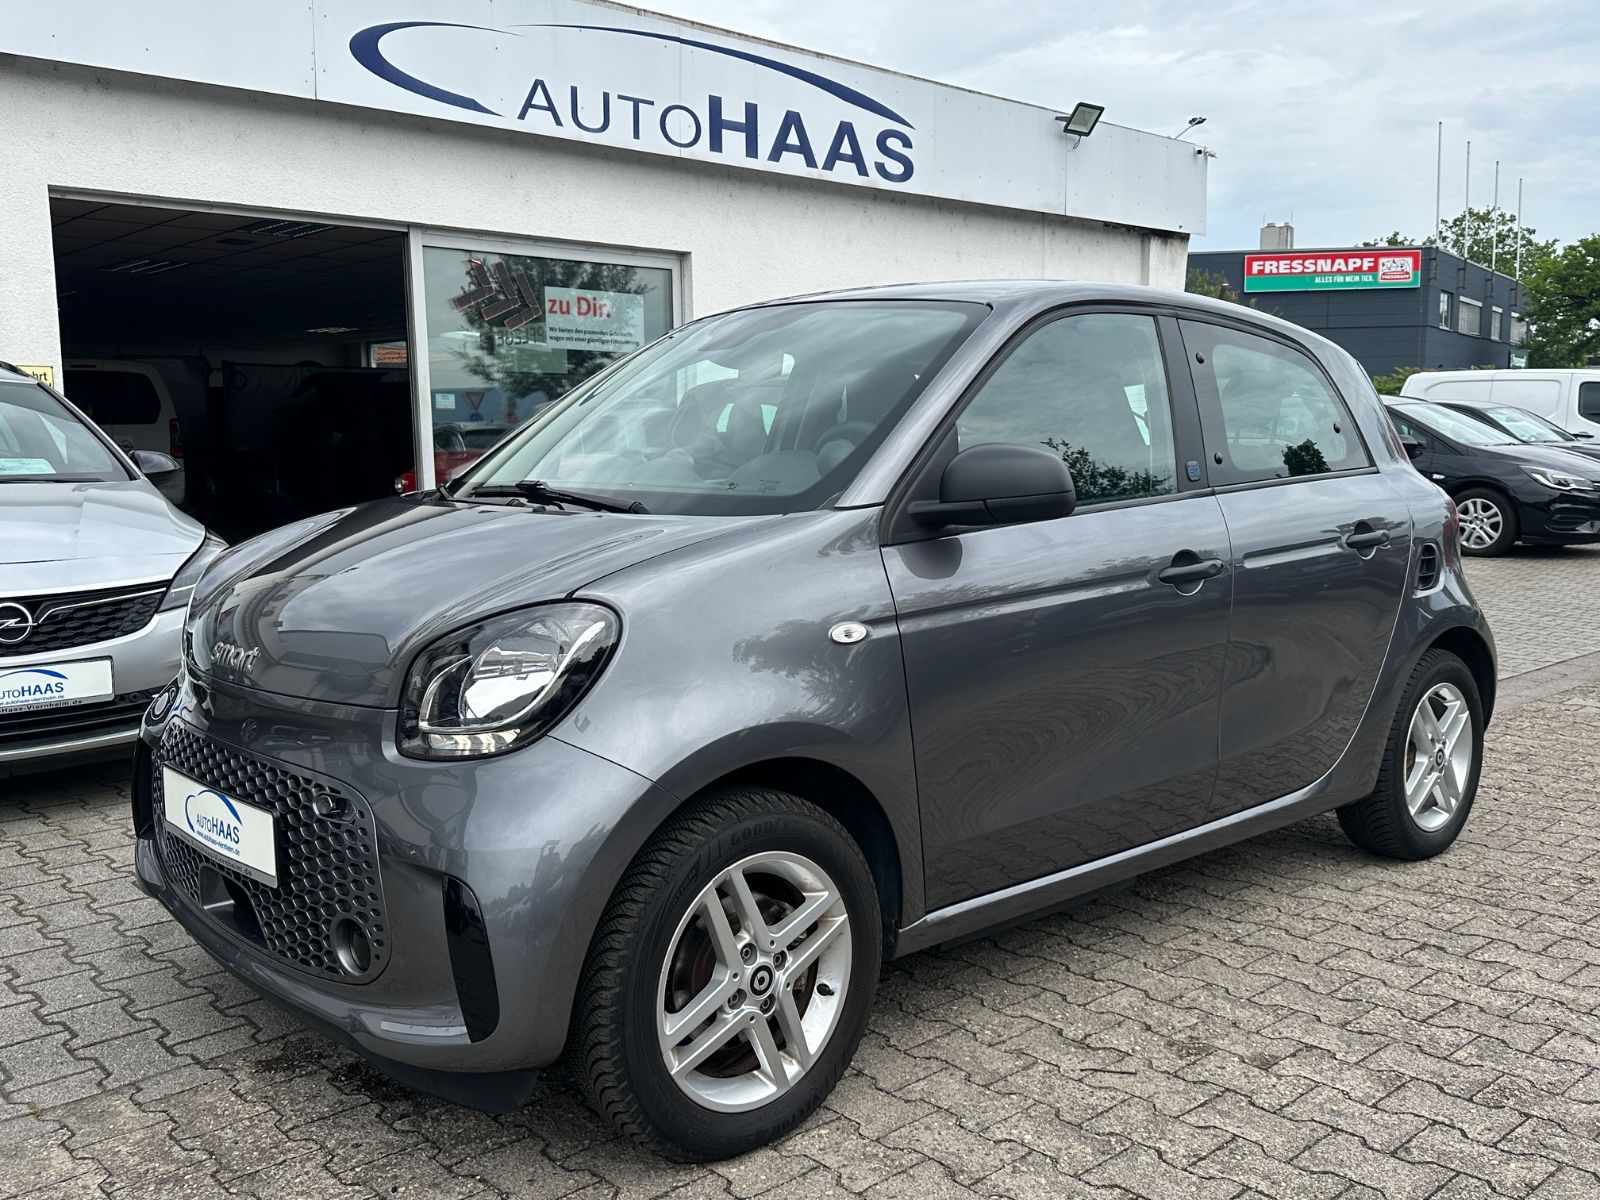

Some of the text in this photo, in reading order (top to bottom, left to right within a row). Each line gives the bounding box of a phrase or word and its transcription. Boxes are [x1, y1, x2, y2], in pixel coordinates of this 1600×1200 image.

[1251, 257, 1375, 274] FRESSNAPF
[1315, 275, 1333, 283] ALLES
[1333, 274, 1344, 283] FÜR
[547, 296, 611, 318] zu Dir.
[0, 682, 64, 700] UTOHAAS
